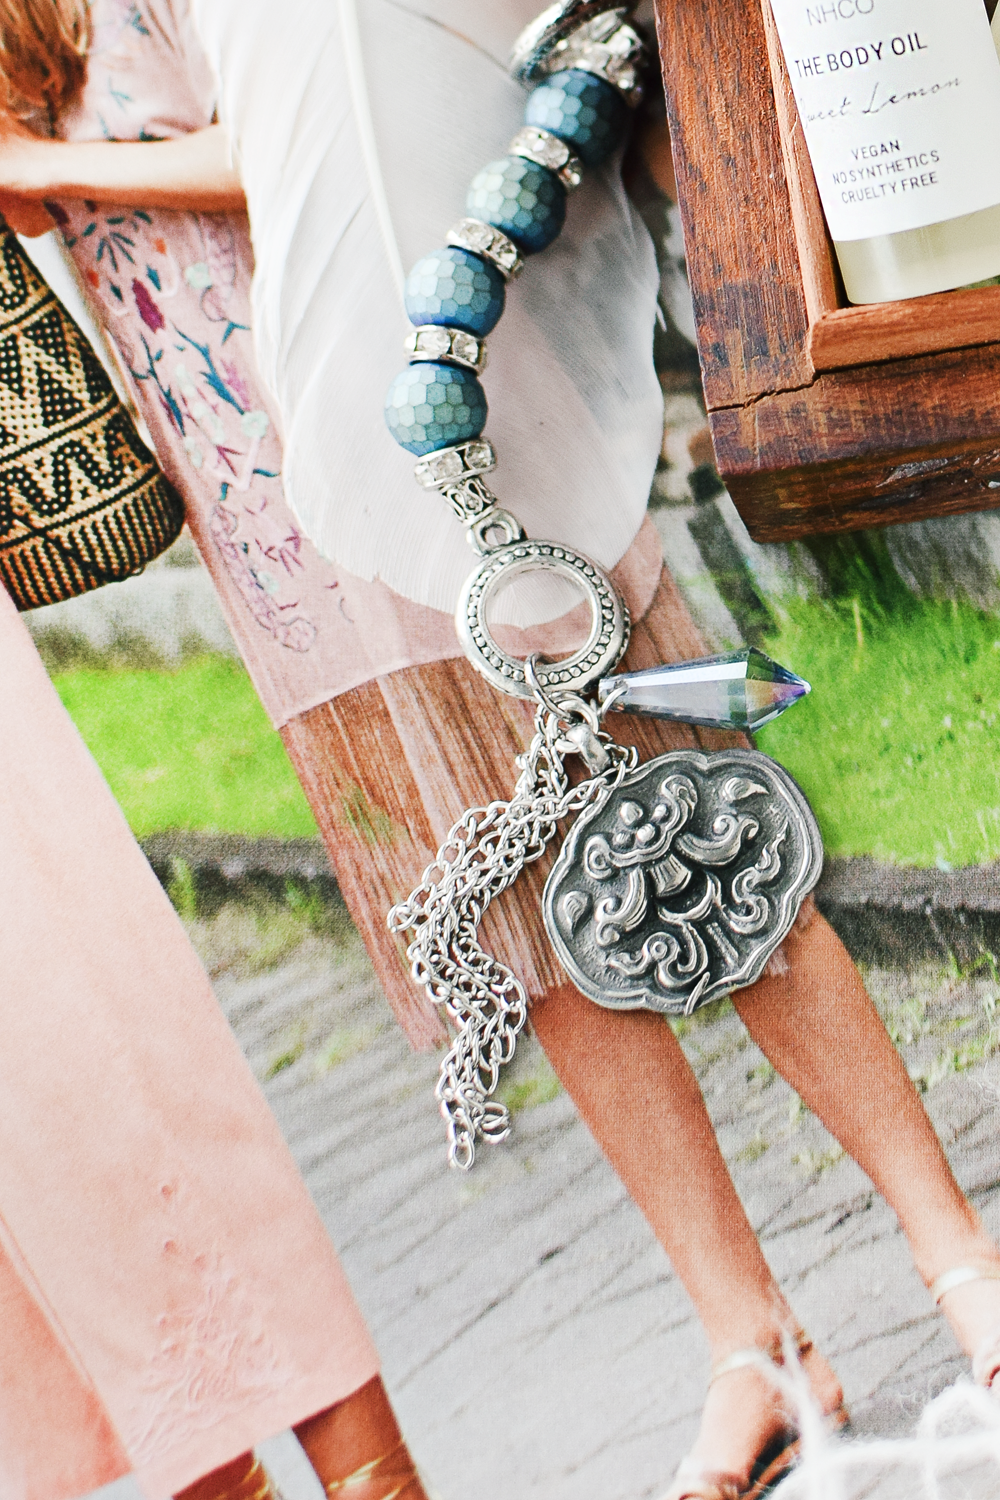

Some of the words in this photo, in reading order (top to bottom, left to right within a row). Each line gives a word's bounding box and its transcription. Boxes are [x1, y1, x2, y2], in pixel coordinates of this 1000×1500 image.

[795, 56, 825, 78] THE
[827, 41, 884, 72] BODY
[891, 32, 928, 56] OIL
[862, 77, 962, 114] Lemon
[832, 171, 848, 185] NO
[848, 150, 940, 183] SYNTHETICS
[851, 139, 901, 161] VEGAN
[841, 183, 898, 205] CRUELTY
[901, 171, 939, 192] FREE
